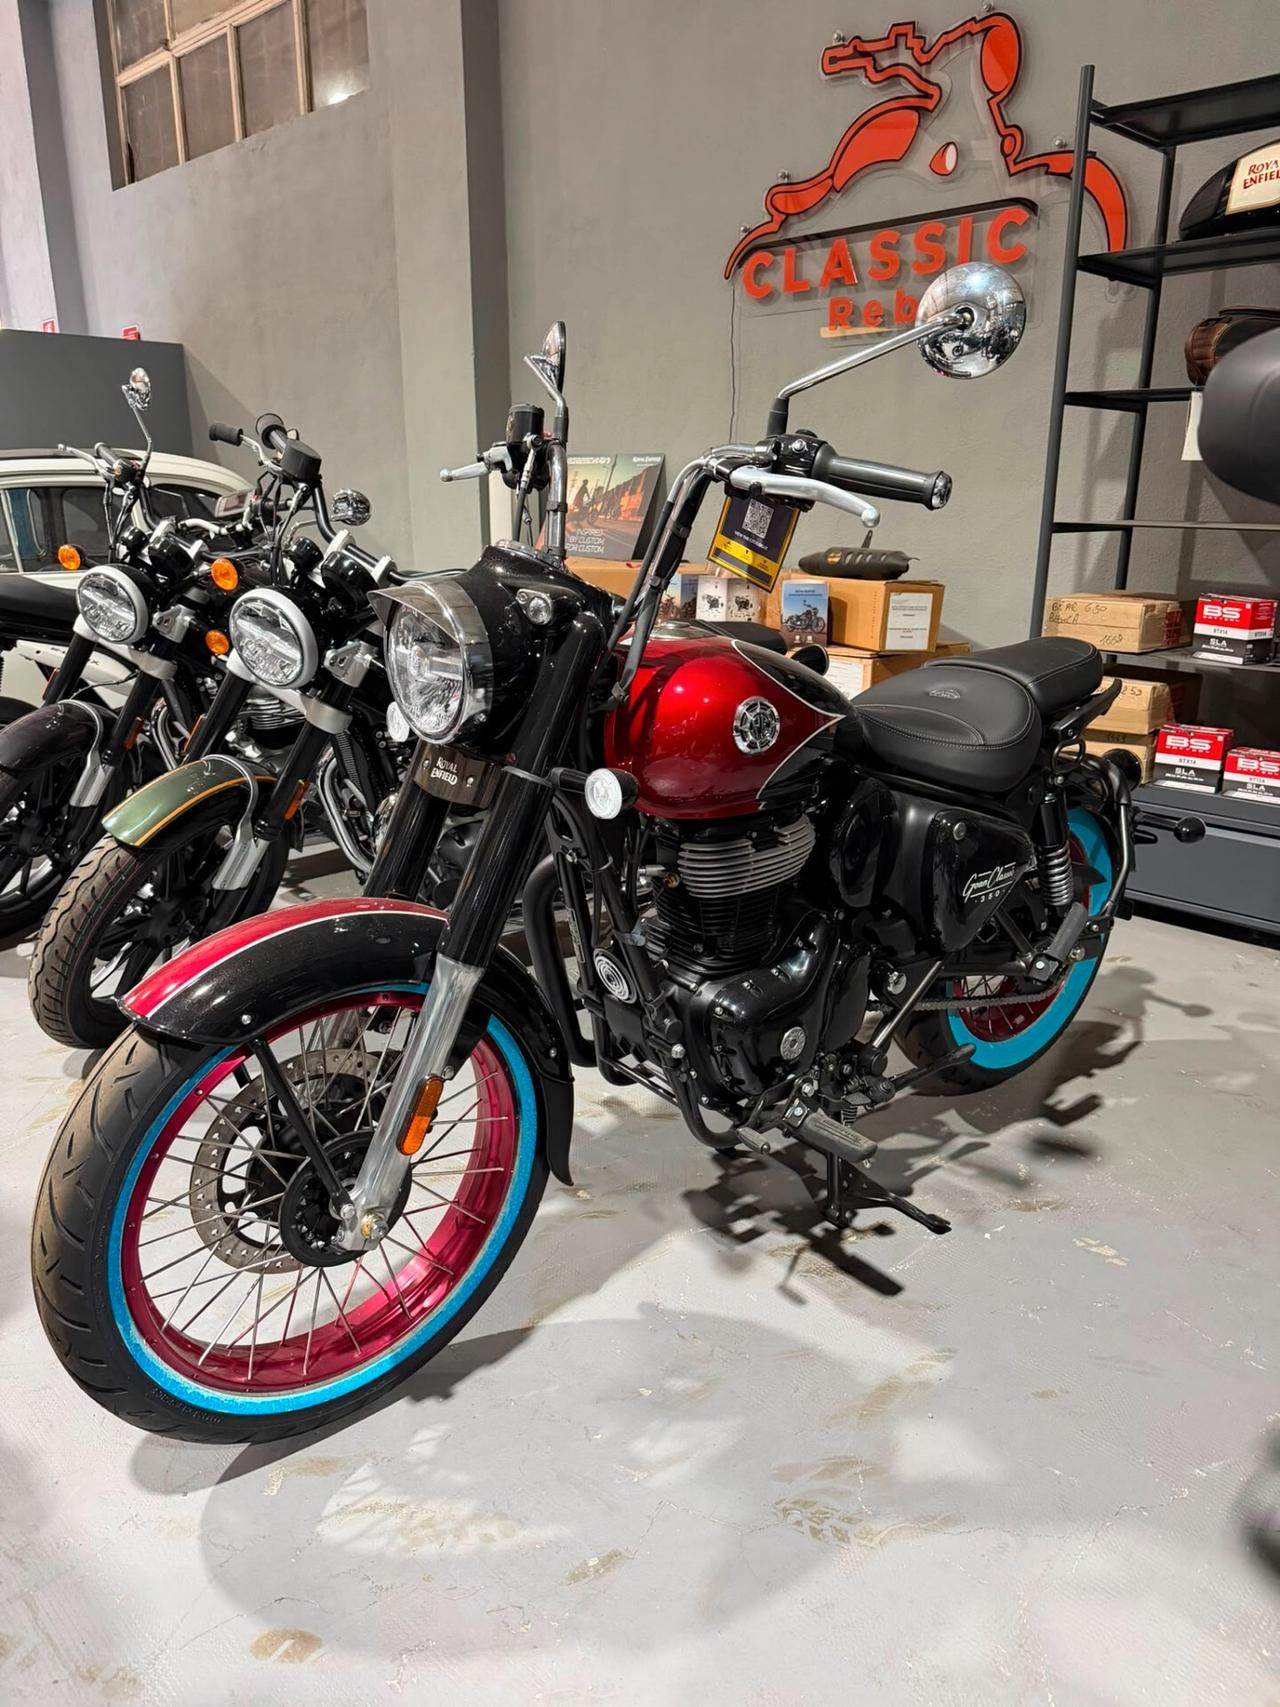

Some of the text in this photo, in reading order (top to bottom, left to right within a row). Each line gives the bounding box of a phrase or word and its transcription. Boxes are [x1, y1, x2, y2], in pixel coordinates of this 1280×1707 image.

[742, 207, 1031, 299] CLASSIC
[1203, 604, 1242, 619] BS
[1209, 638, 1227, 648] SLA
[1166, 735, 1213, 751] BS
[436, 756, 457, 773] ROYAL
[1174, 767, 1196, 777] SLA
[1237, 758, 1280, 773] BS
[430, 767, 458, 785] ENFIELD
[1245, 783, 1266, 792] SLA
